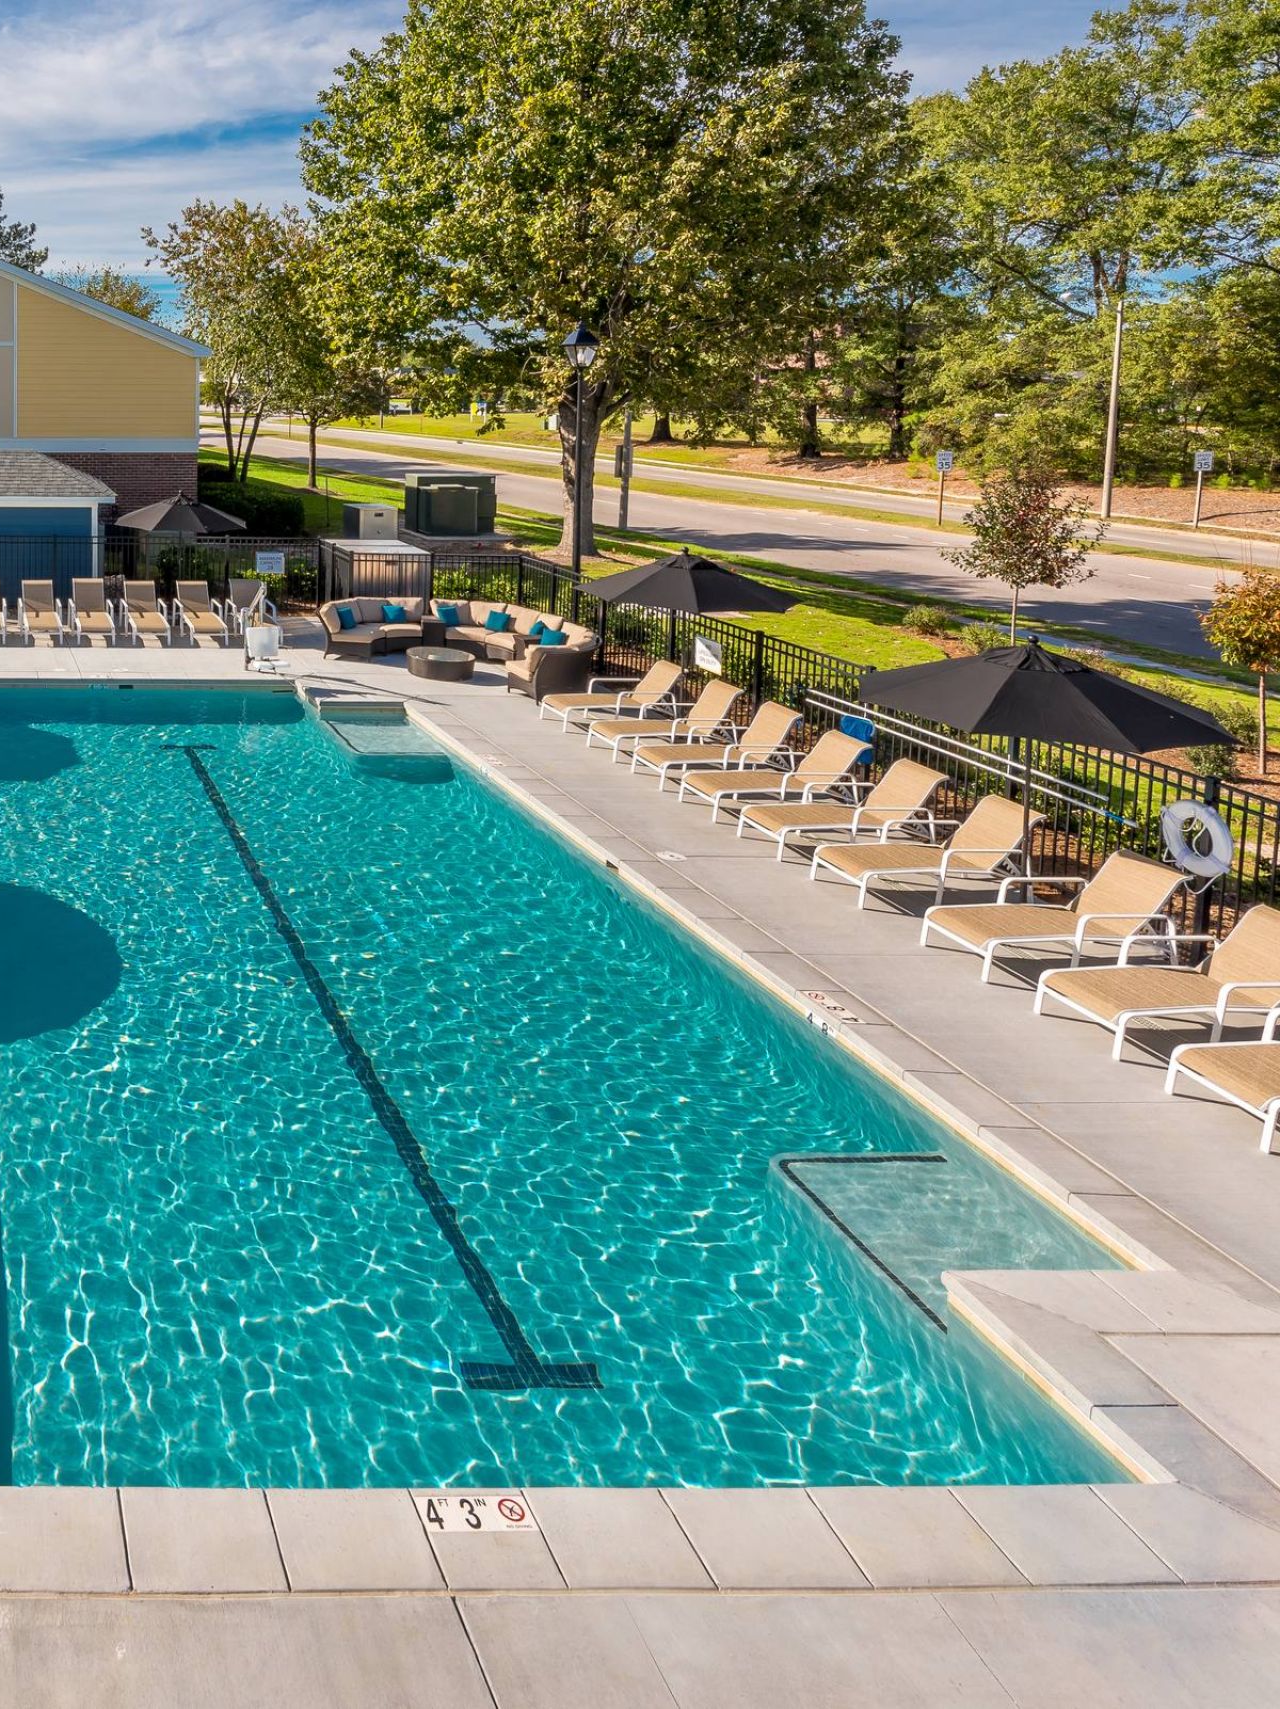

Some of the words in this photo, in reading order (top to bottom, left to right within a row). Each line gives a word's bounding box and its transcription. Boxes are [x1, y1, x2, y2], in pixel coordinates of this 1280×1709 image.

[938, 461, 951, 470] 35
[1196, 461, 1211, 470] 35
[806, 1012, 813, 1024] 4
[426, 1498, 445, 1530] 4
[436, 1498, 449, 1507] FT
[459, 1498, 482, 1530] 3
[473, 1498, 487, 1507] IN
